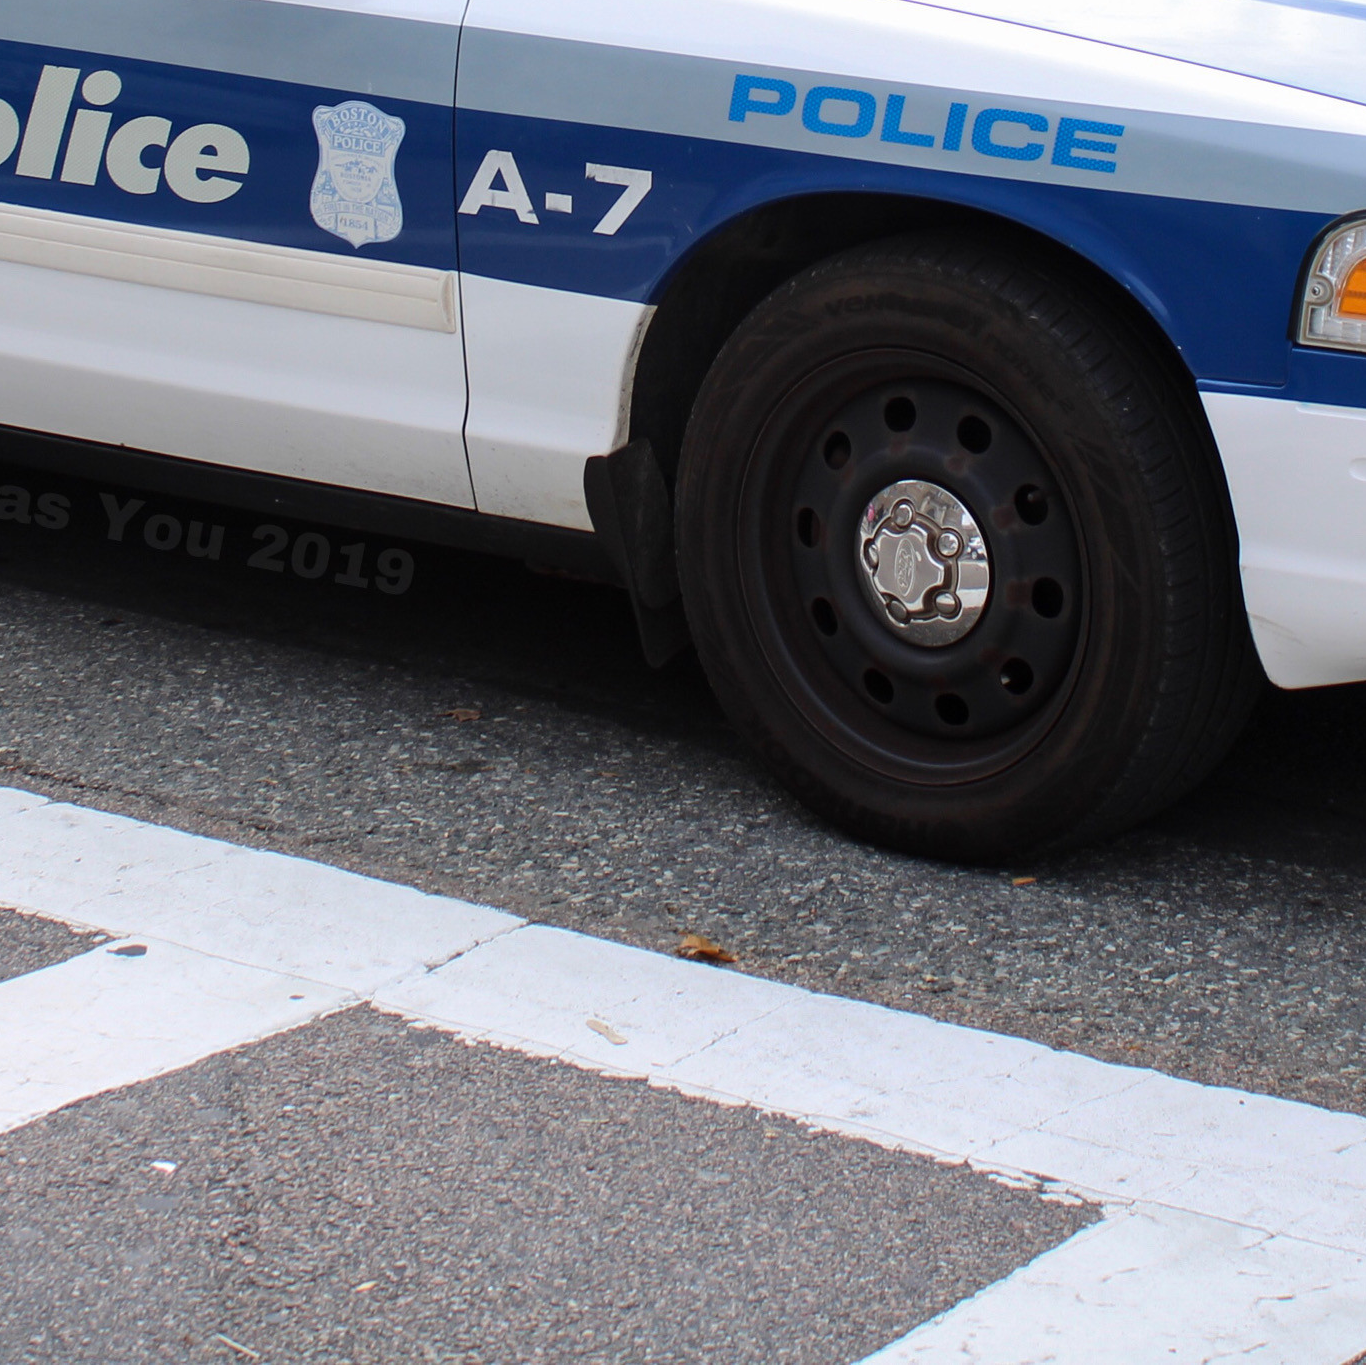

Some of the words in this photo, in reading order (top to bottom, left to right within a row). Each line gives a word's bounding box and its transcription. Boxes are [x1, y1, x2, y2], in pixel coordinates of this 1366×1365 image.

[331, 107, 386, 133] BOSTON
[333, 136, 382, 153] POLICE
[727, 73, 1125, 173] POLICE
[457, 149, 652, 235] A-7
